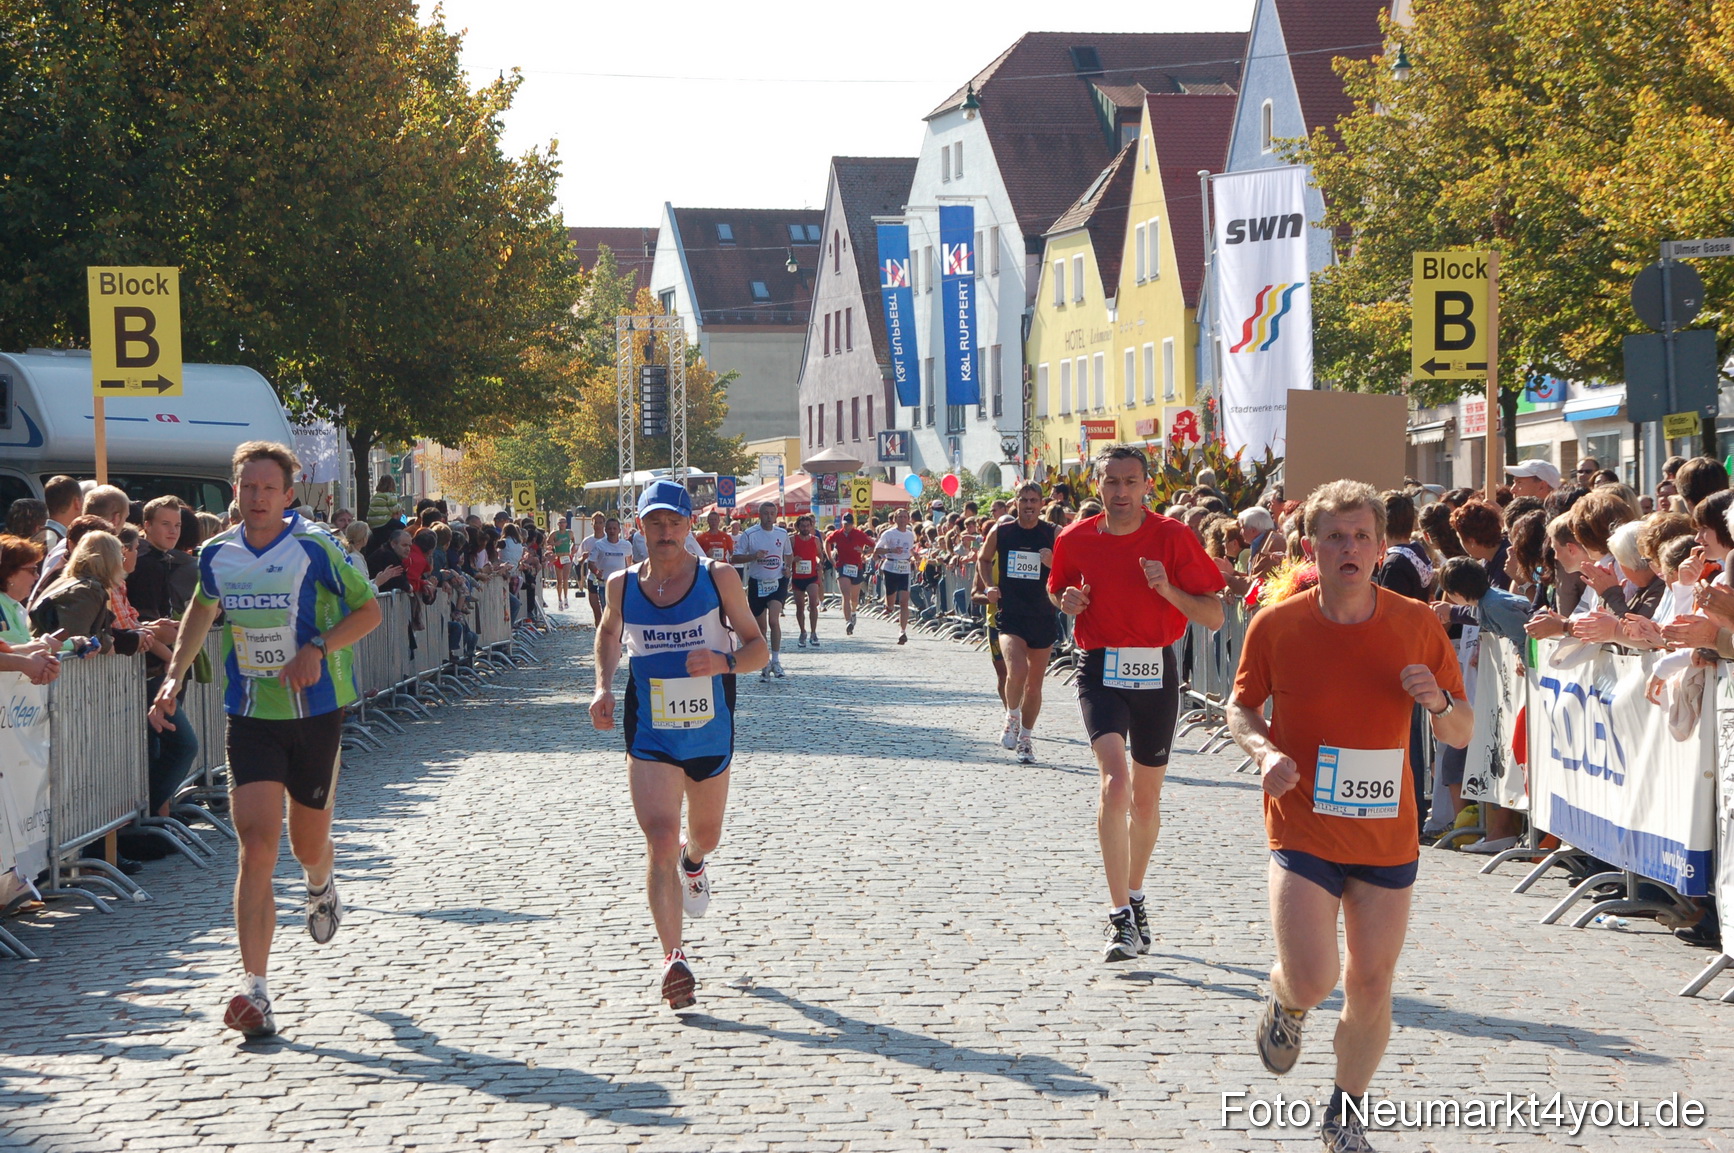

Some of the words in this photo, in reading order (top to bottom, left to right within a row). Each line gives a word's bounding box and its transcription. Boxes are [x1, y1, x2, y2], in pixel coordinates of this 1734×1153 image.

[1225, 212, 1304, 245] swn
[1674, 243, 1701, 255] Ulmer
[1703, 242, 1731, 253] Gasse
[1423, 257, 1488, 280] Block
[100, 272, 170, 296] Block
[958, 281, 971, 351] RUPPERT
[1434, 290, 1476, 351] B
[114, 306, 160, 369] B
[1065, 328, 1086, 351] HOTEL
[961, 352, 972, 382] K&L
[1229, 403, 1272, 414] stadtwerke
[518, 490, 531, 507] C
[718, 497, 736, 506] TAXI
[856, 488, 868, 504] C
[1016, 562, 1039, 573] 2094
[763, 585, 778, 593] 2567
[223, 592, 291, 610] BOCK
[245, 631, 282, 643] Friedrich
[642, 624, 704, 643] Margraf
[644, 638, 706, 650] Bauunternehmen
[255, 649, 286, 664] 503
[1122, 662, 1160, 676] 3585
[668, 698, 709, 715] 1158
[1341, 779, 1395, 799] 3596
